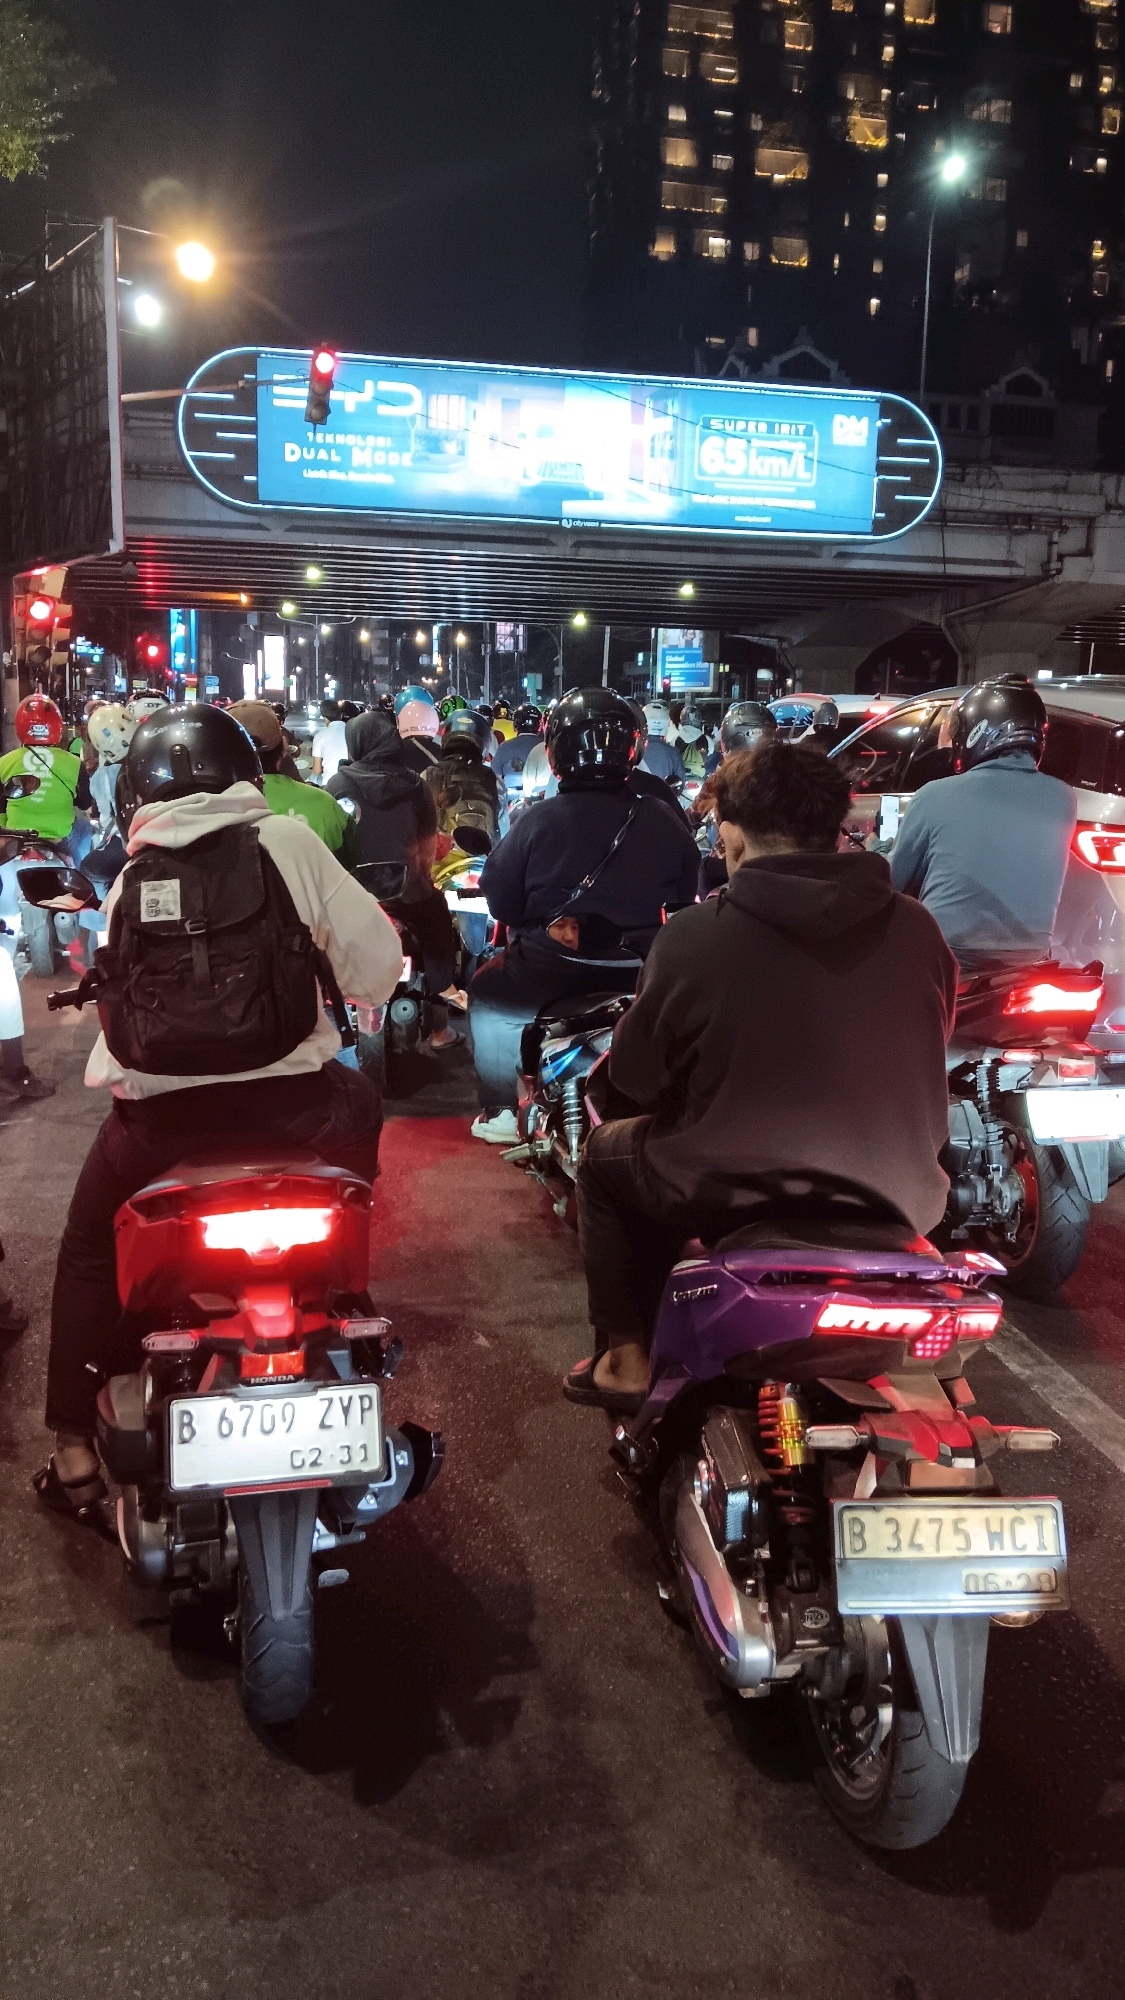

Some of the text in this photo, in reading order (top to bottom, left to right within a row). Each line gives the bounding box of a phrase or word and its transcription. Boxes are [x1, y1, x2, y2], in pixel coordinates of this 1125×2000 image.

[710, 419, 807, 436] SUPER IRIT
[833, 414, 869, 438] DM
[306, 432, 392, 447] TEKNOLOGI
[700, 435, 748, 476] 65
[250, 1374, 295, 1384] HONDA
[178, 1409, 197, 1444] B
[318, 1393, 374, 1429] ZYP
[848, 1514, 1048, 1555] B 3475 WCI
